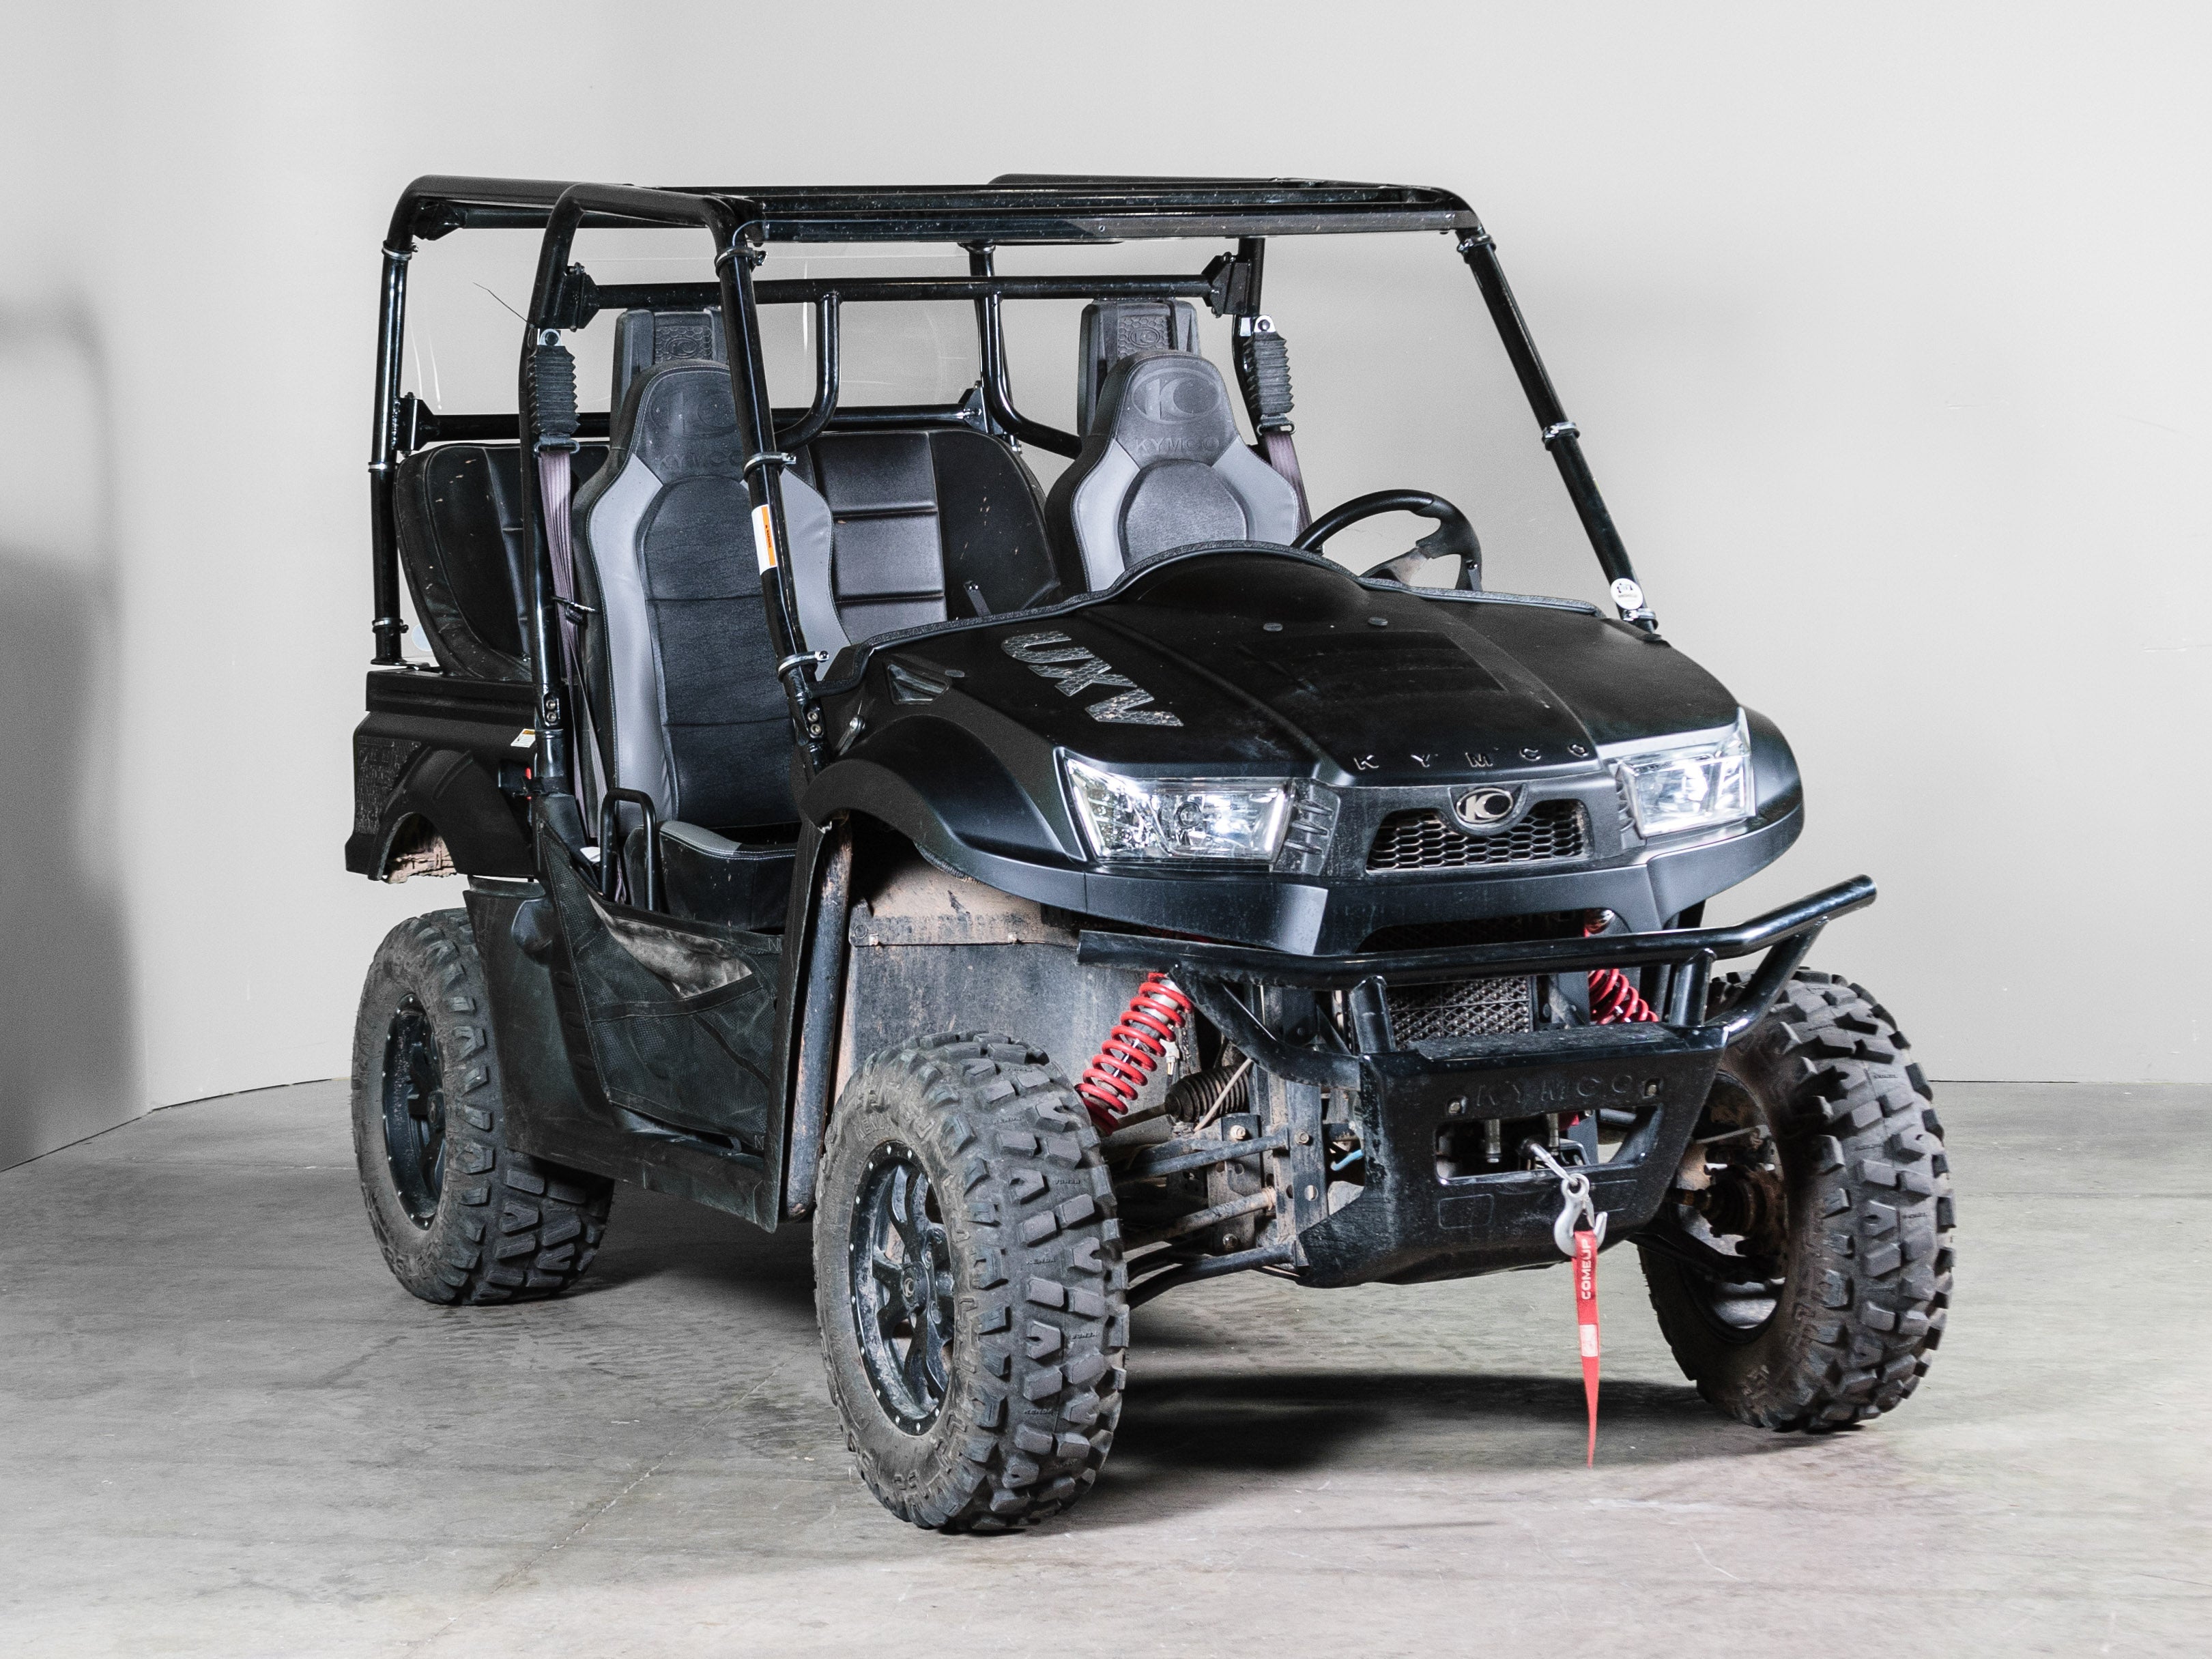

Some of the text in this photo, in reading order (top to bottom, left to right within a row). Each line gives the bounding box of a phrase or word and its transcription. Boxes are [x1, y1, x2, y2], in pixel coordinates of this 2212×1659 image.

[1136, 436, 1220, 453] KYMCO
[1001, 630, 1184, 727] UXV
[1353, 743, 1589, 770] KYMCO
[1475, 1074, 1633, 1107] KYMCO
[1581, 1239, 1594, 1300] COMEUP
